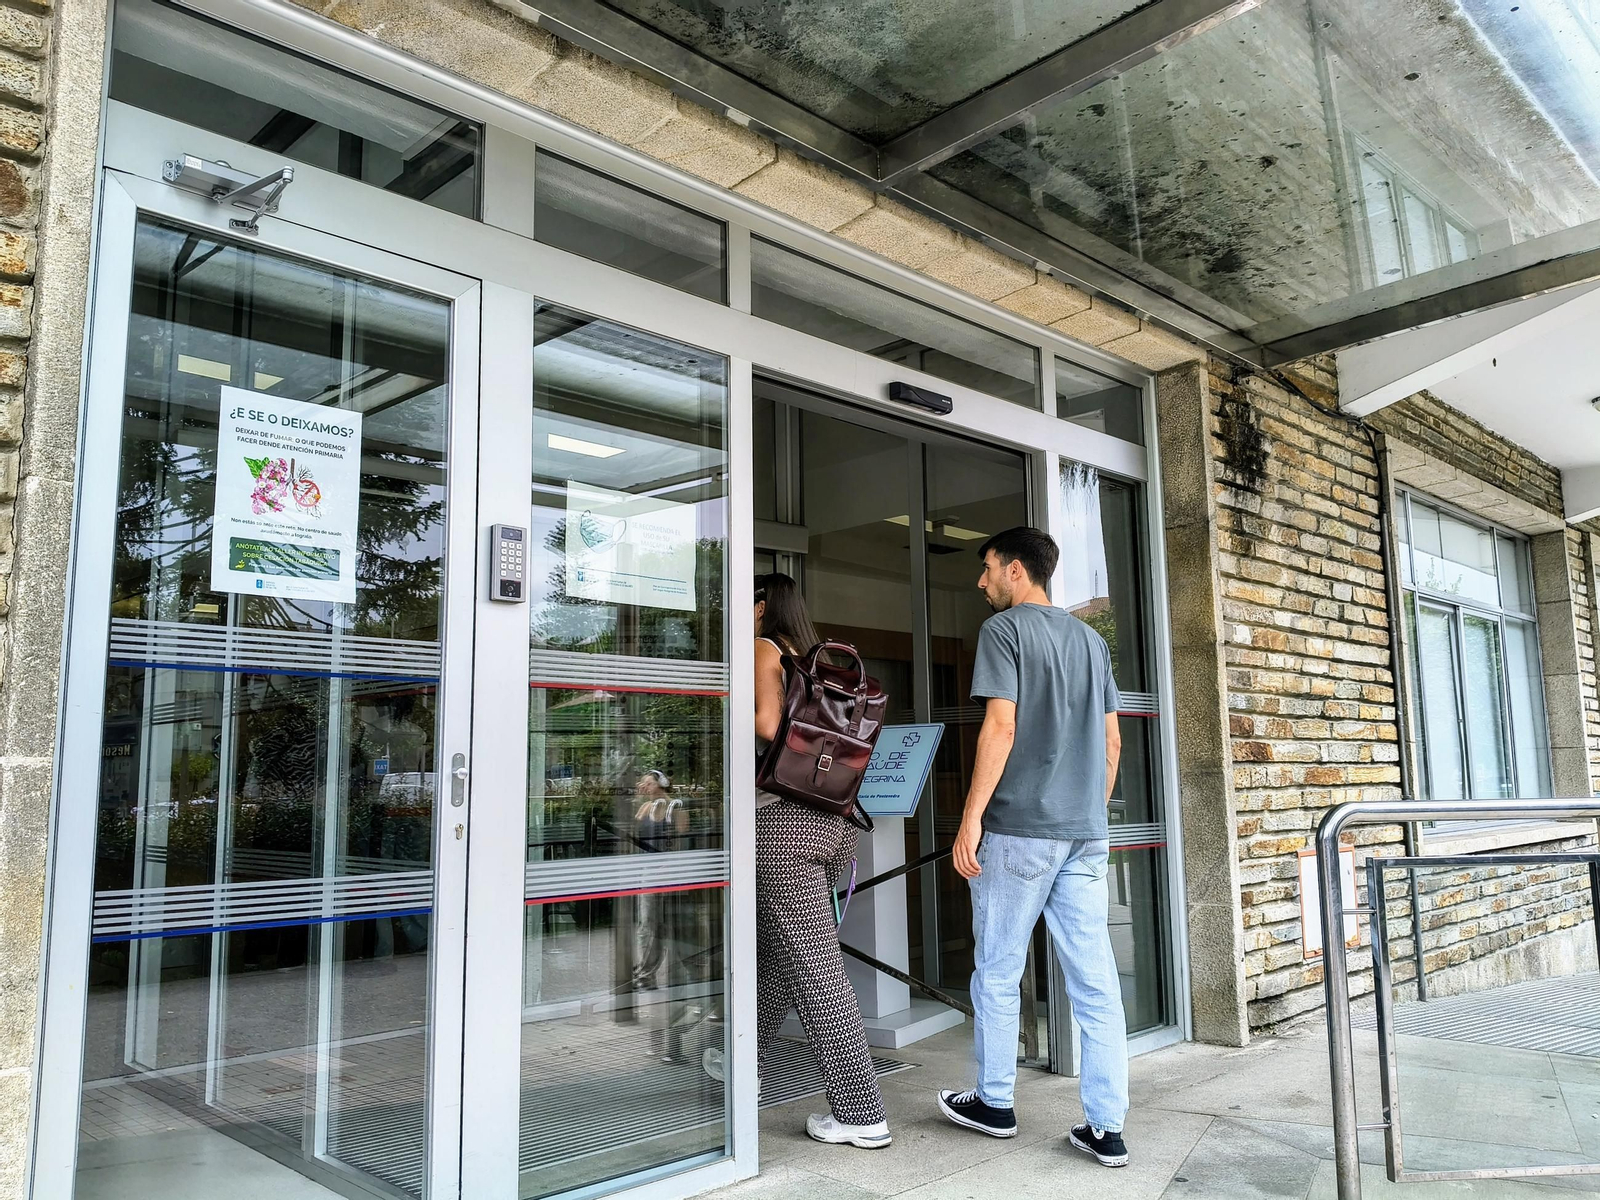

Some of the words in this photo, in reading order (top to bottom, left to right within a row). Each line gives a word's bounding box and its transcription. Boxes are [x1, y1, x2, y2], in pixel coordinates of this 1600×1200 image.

[230, 407, 245, 419] ¿E
[248, 410, 265, 422] SE
[268, 413, 278, 424] O
[281, 416, 354, 438] DEIXAMOS?
[235, 426, 259, 437] DEIXAR
[260, 431, 269, 439] DE
[301, 438, 315, 447] QUE
[316, 441, 346, 452] PODEMOS
[237, 435, 258, 445] FACER
[259, 439, 280, 449] DENDE
[281, 443, 314, 454] ATENCIÓN
[314, 449, 344, 459] PRIMARIA
[235, 542, 263, 551] ANÓTATE
[242, 552, 263, 560] SOBRE
[889, 752, 911, 760] DE
[866, 759, 907, 770] AÚDE
[863, 775, 906, 783] EGRINA
